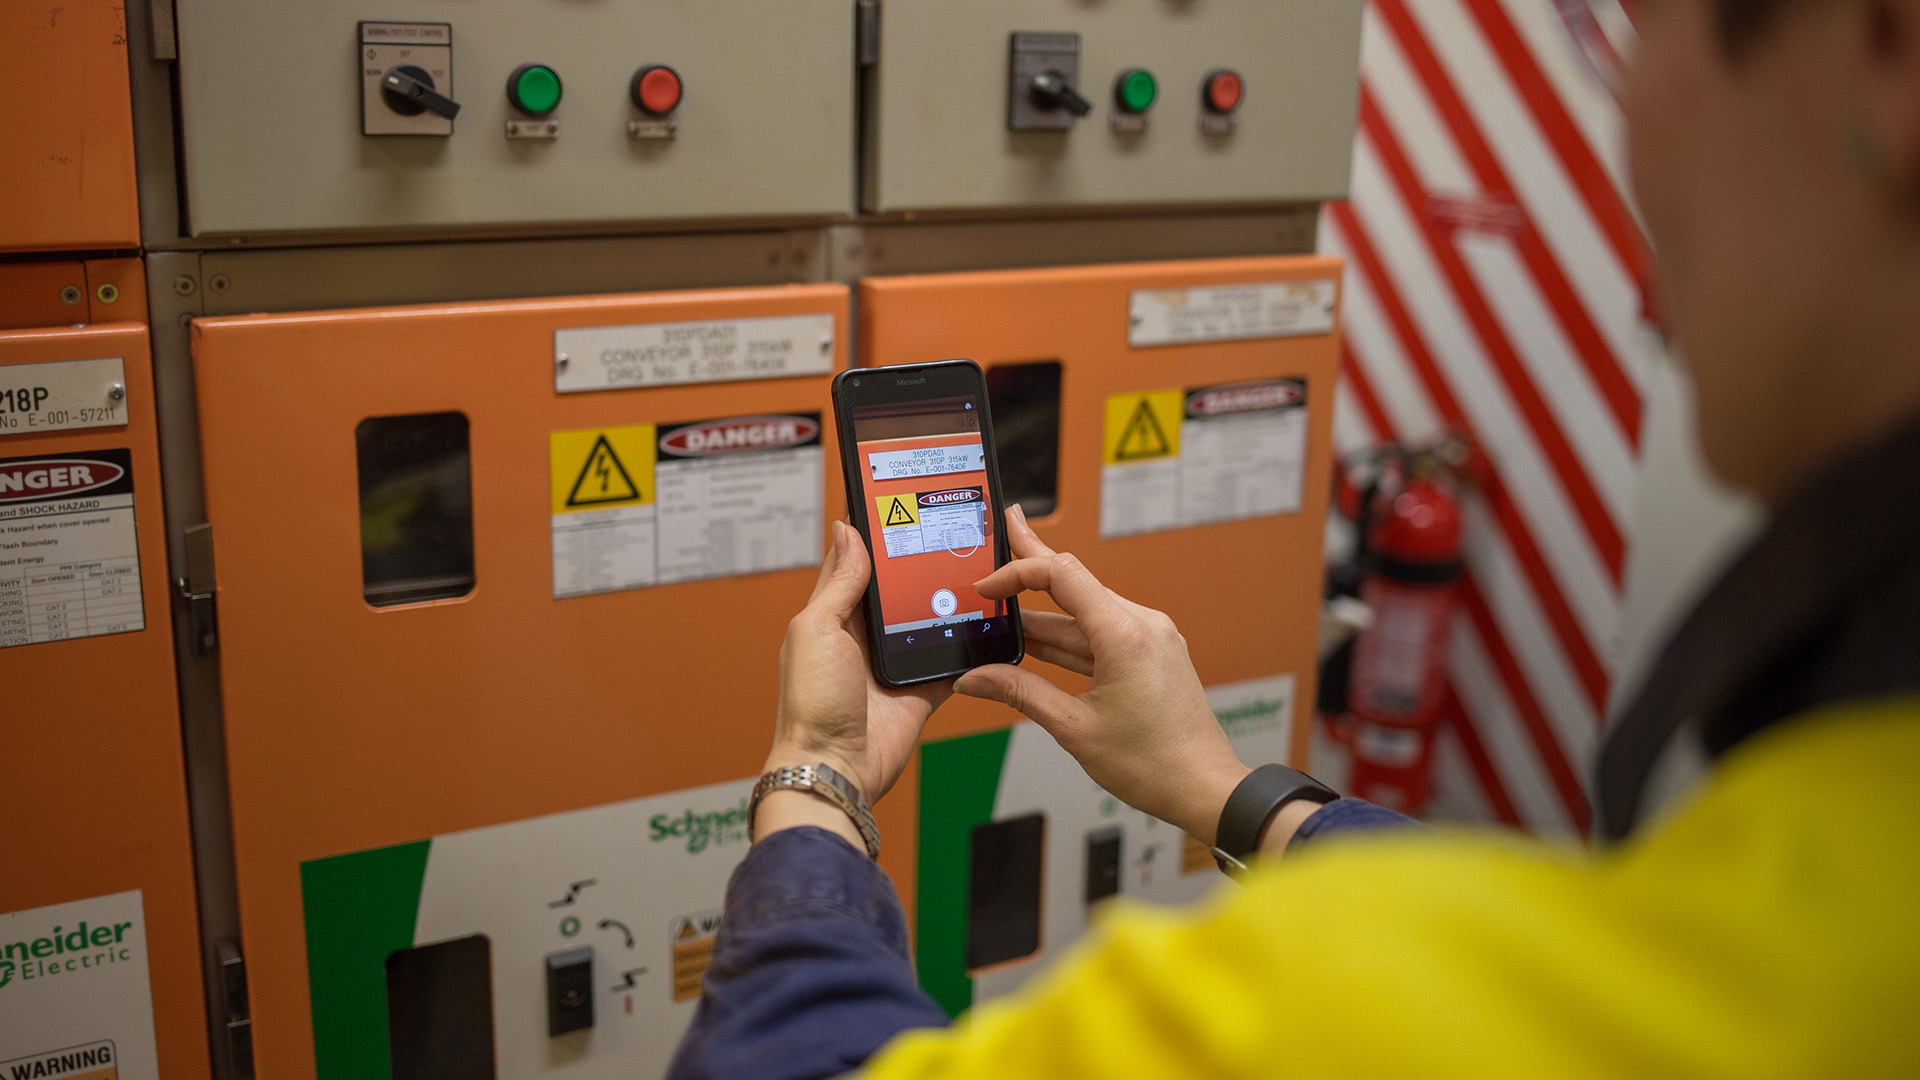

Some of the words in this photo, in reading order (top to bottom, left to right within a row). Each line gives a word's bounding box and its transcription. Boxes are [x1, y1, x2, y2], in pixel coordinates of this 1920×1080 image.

[897, 377, 926, 386] Microsoft
[28, 406, 115, 427] E-001-57211
[686, 422, 798, 450] DANGER
[912, 449, 945, 459] 310PDA01
[888, 458, 927, 469] CONVEYOR
[929, 456, 945, 465] 310P
[948, 454, 969, 464] 315kW
[892, 467, 909, 477] DRG
[926, 463, 967, 474] E-001-76406
[928, 491, 973, 504] DANGER
[0, 508, 16, 518] and
[19, 505, 56, 516] SHOCK
[58, 500, 100, 512] HAZARD
[8, 524, 35, 534] Hazard
[37, 522, 57, 530] when
[59, 520, 80, 528] cover
[82, 516, 110, 527] opened
[21, 539, 58, 549] Boundary
[18, 555, 44, 565] Energy
[74, 562, 102, 571] Category
[0, 637, 29, 646] CTION
[0, 921, 132, 961] neider
[22, 947, 130, 980] Electric
[12, 1046, 111, 1080] WARNING
